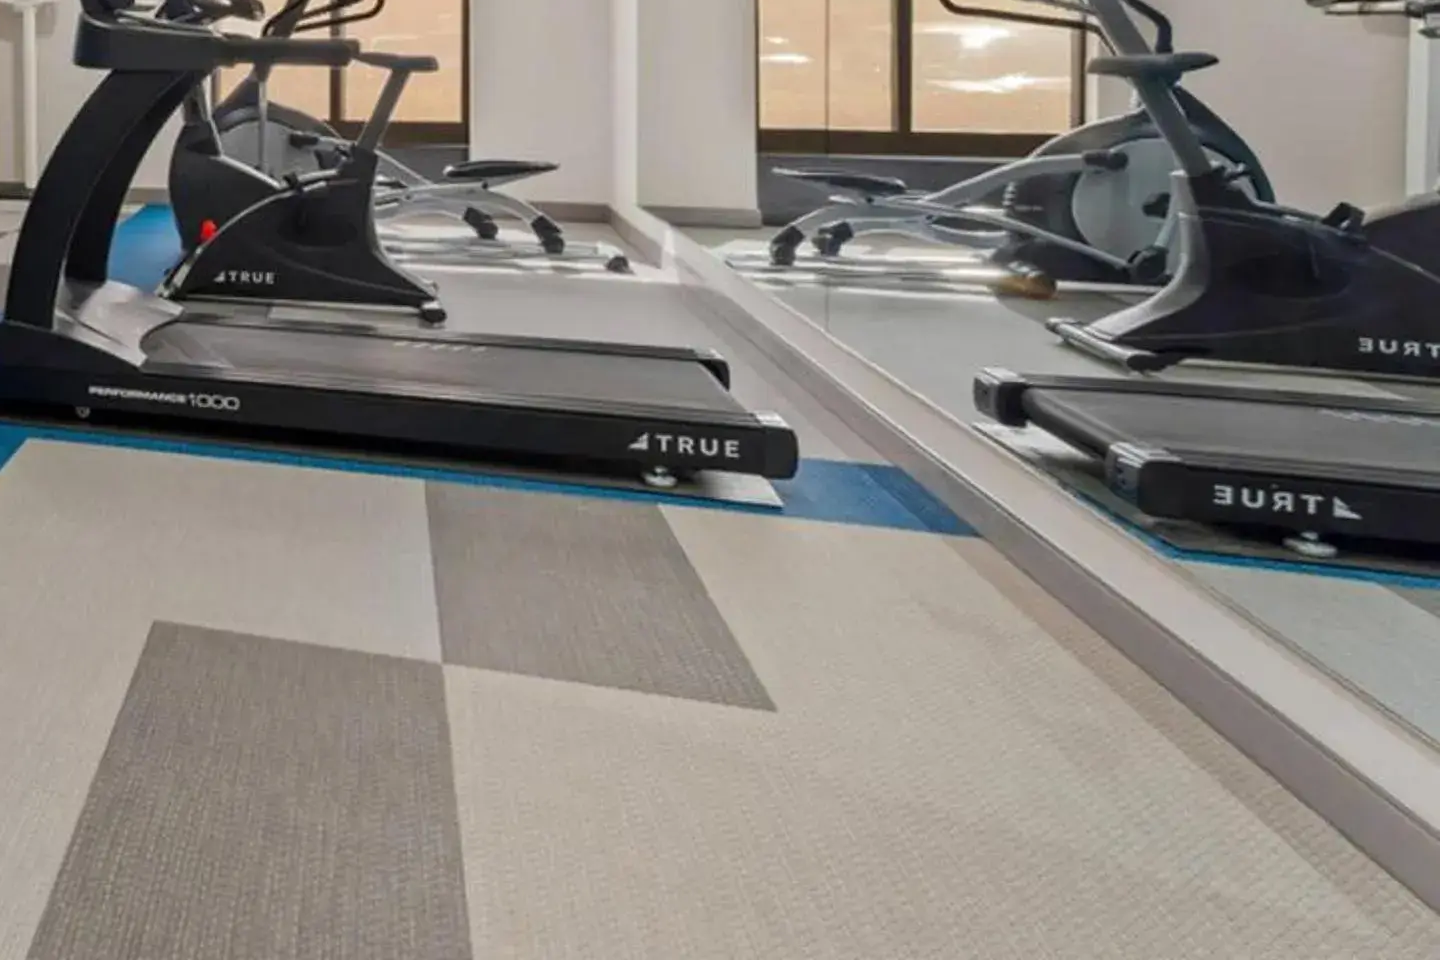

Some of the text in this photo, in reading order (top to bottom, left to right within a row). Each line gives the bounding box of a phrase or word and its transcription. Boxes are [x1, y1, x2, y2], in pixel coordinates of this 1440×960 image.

[228, 270, 275, 284] TRUE
[88, 385, 240, 410] PERFORMANCE 1000
[655, 434, 740, 458] TRUE
